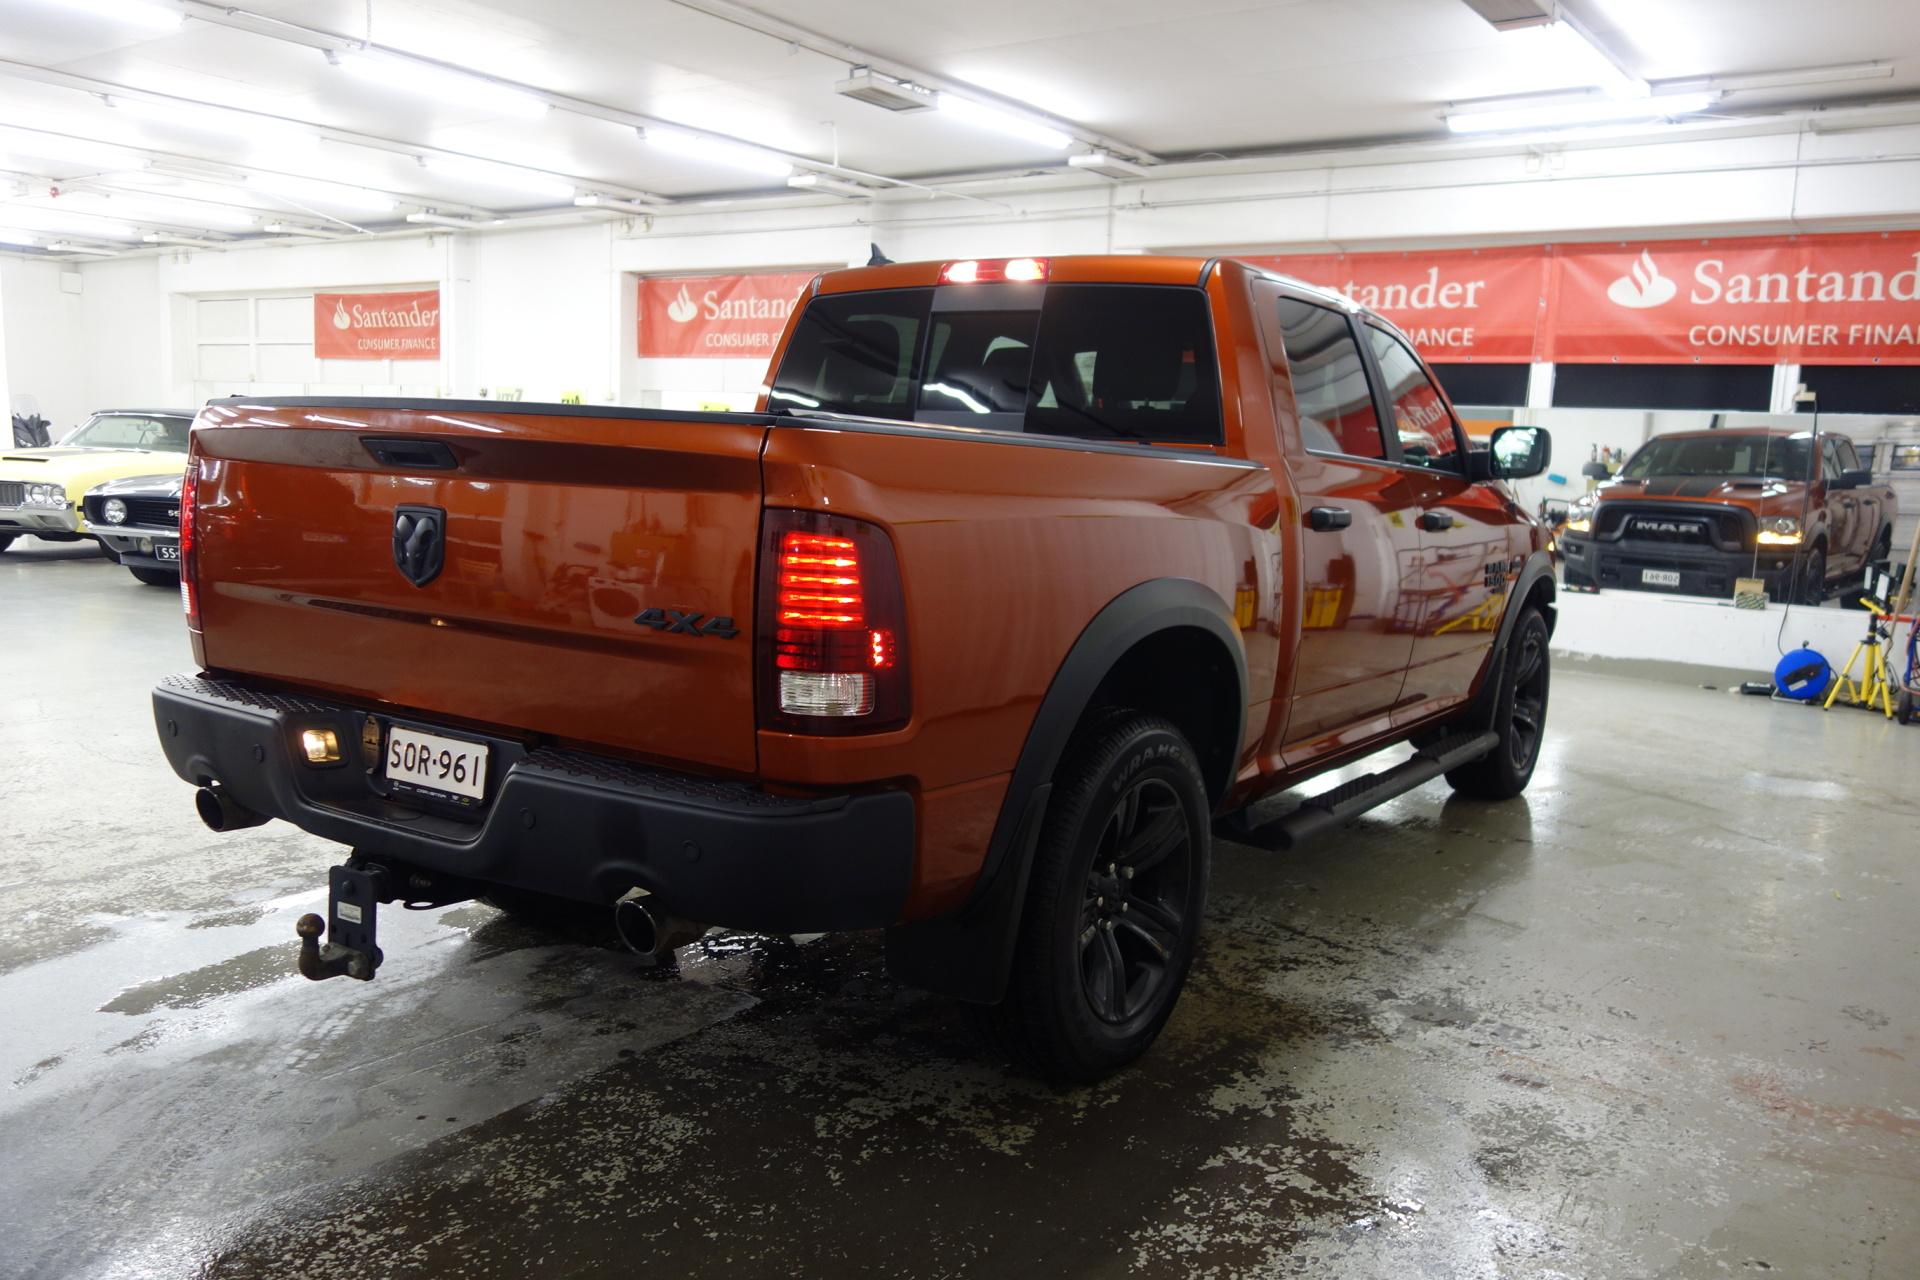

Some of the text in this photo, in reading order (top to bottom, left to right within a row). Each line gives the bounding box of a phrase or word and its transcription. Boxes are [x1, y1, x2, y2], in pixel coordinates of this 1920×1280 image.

[1326, 266, 1485, 310] tander
[352, 301, 438, 328] Santander
[358, 337, 436, 350] CONSUMER FINANCE
[705, 333, 769, 347] CONSUMER
[1689, 324, 1920, 346] CONSUMER FINA
[634, 607, 741, 639] 4X4
